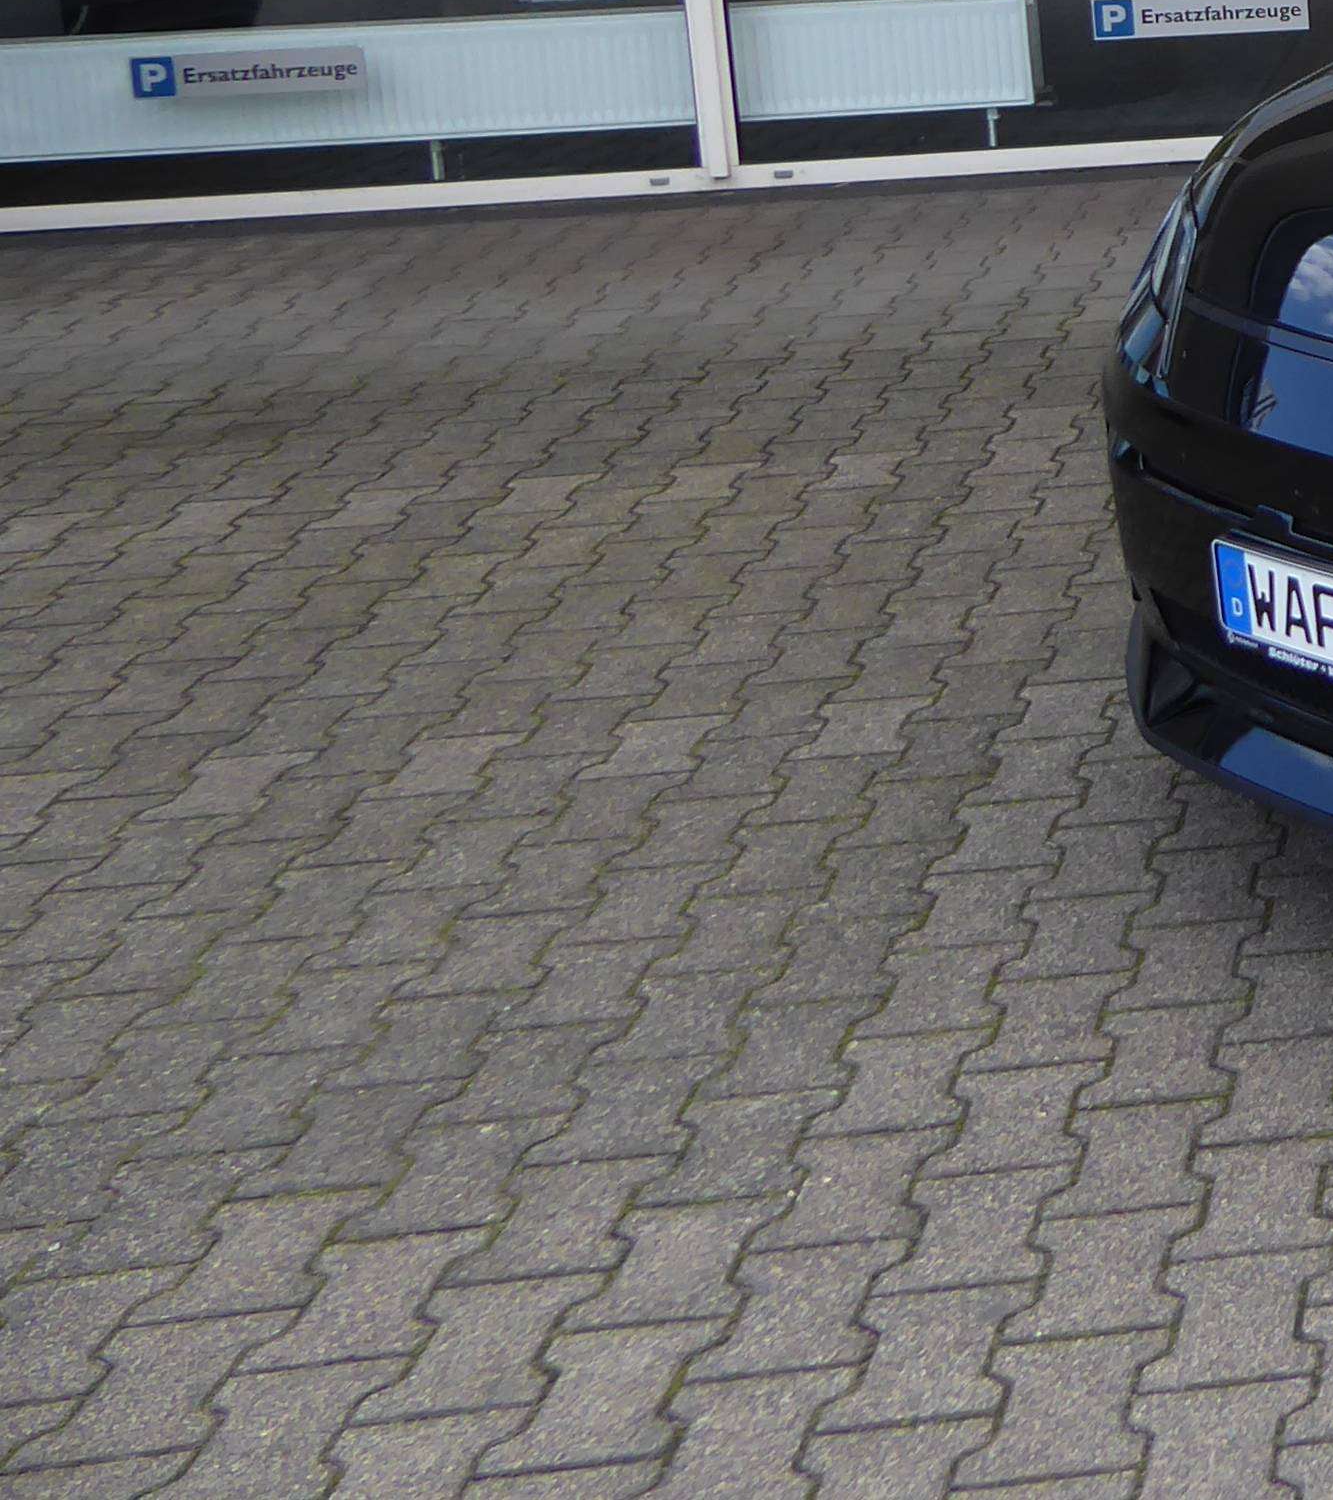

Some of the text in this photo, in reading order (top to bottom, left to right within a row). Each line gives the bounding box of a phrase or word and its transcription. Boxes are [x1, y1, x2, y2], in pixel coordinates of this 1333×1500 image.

[1101, 4, 1302, 32] P Ersatzfahrzeuge
[138, 62, 358, 92] P Ersatzfahrzeuge
[1231, 597, 1243, 616] D
